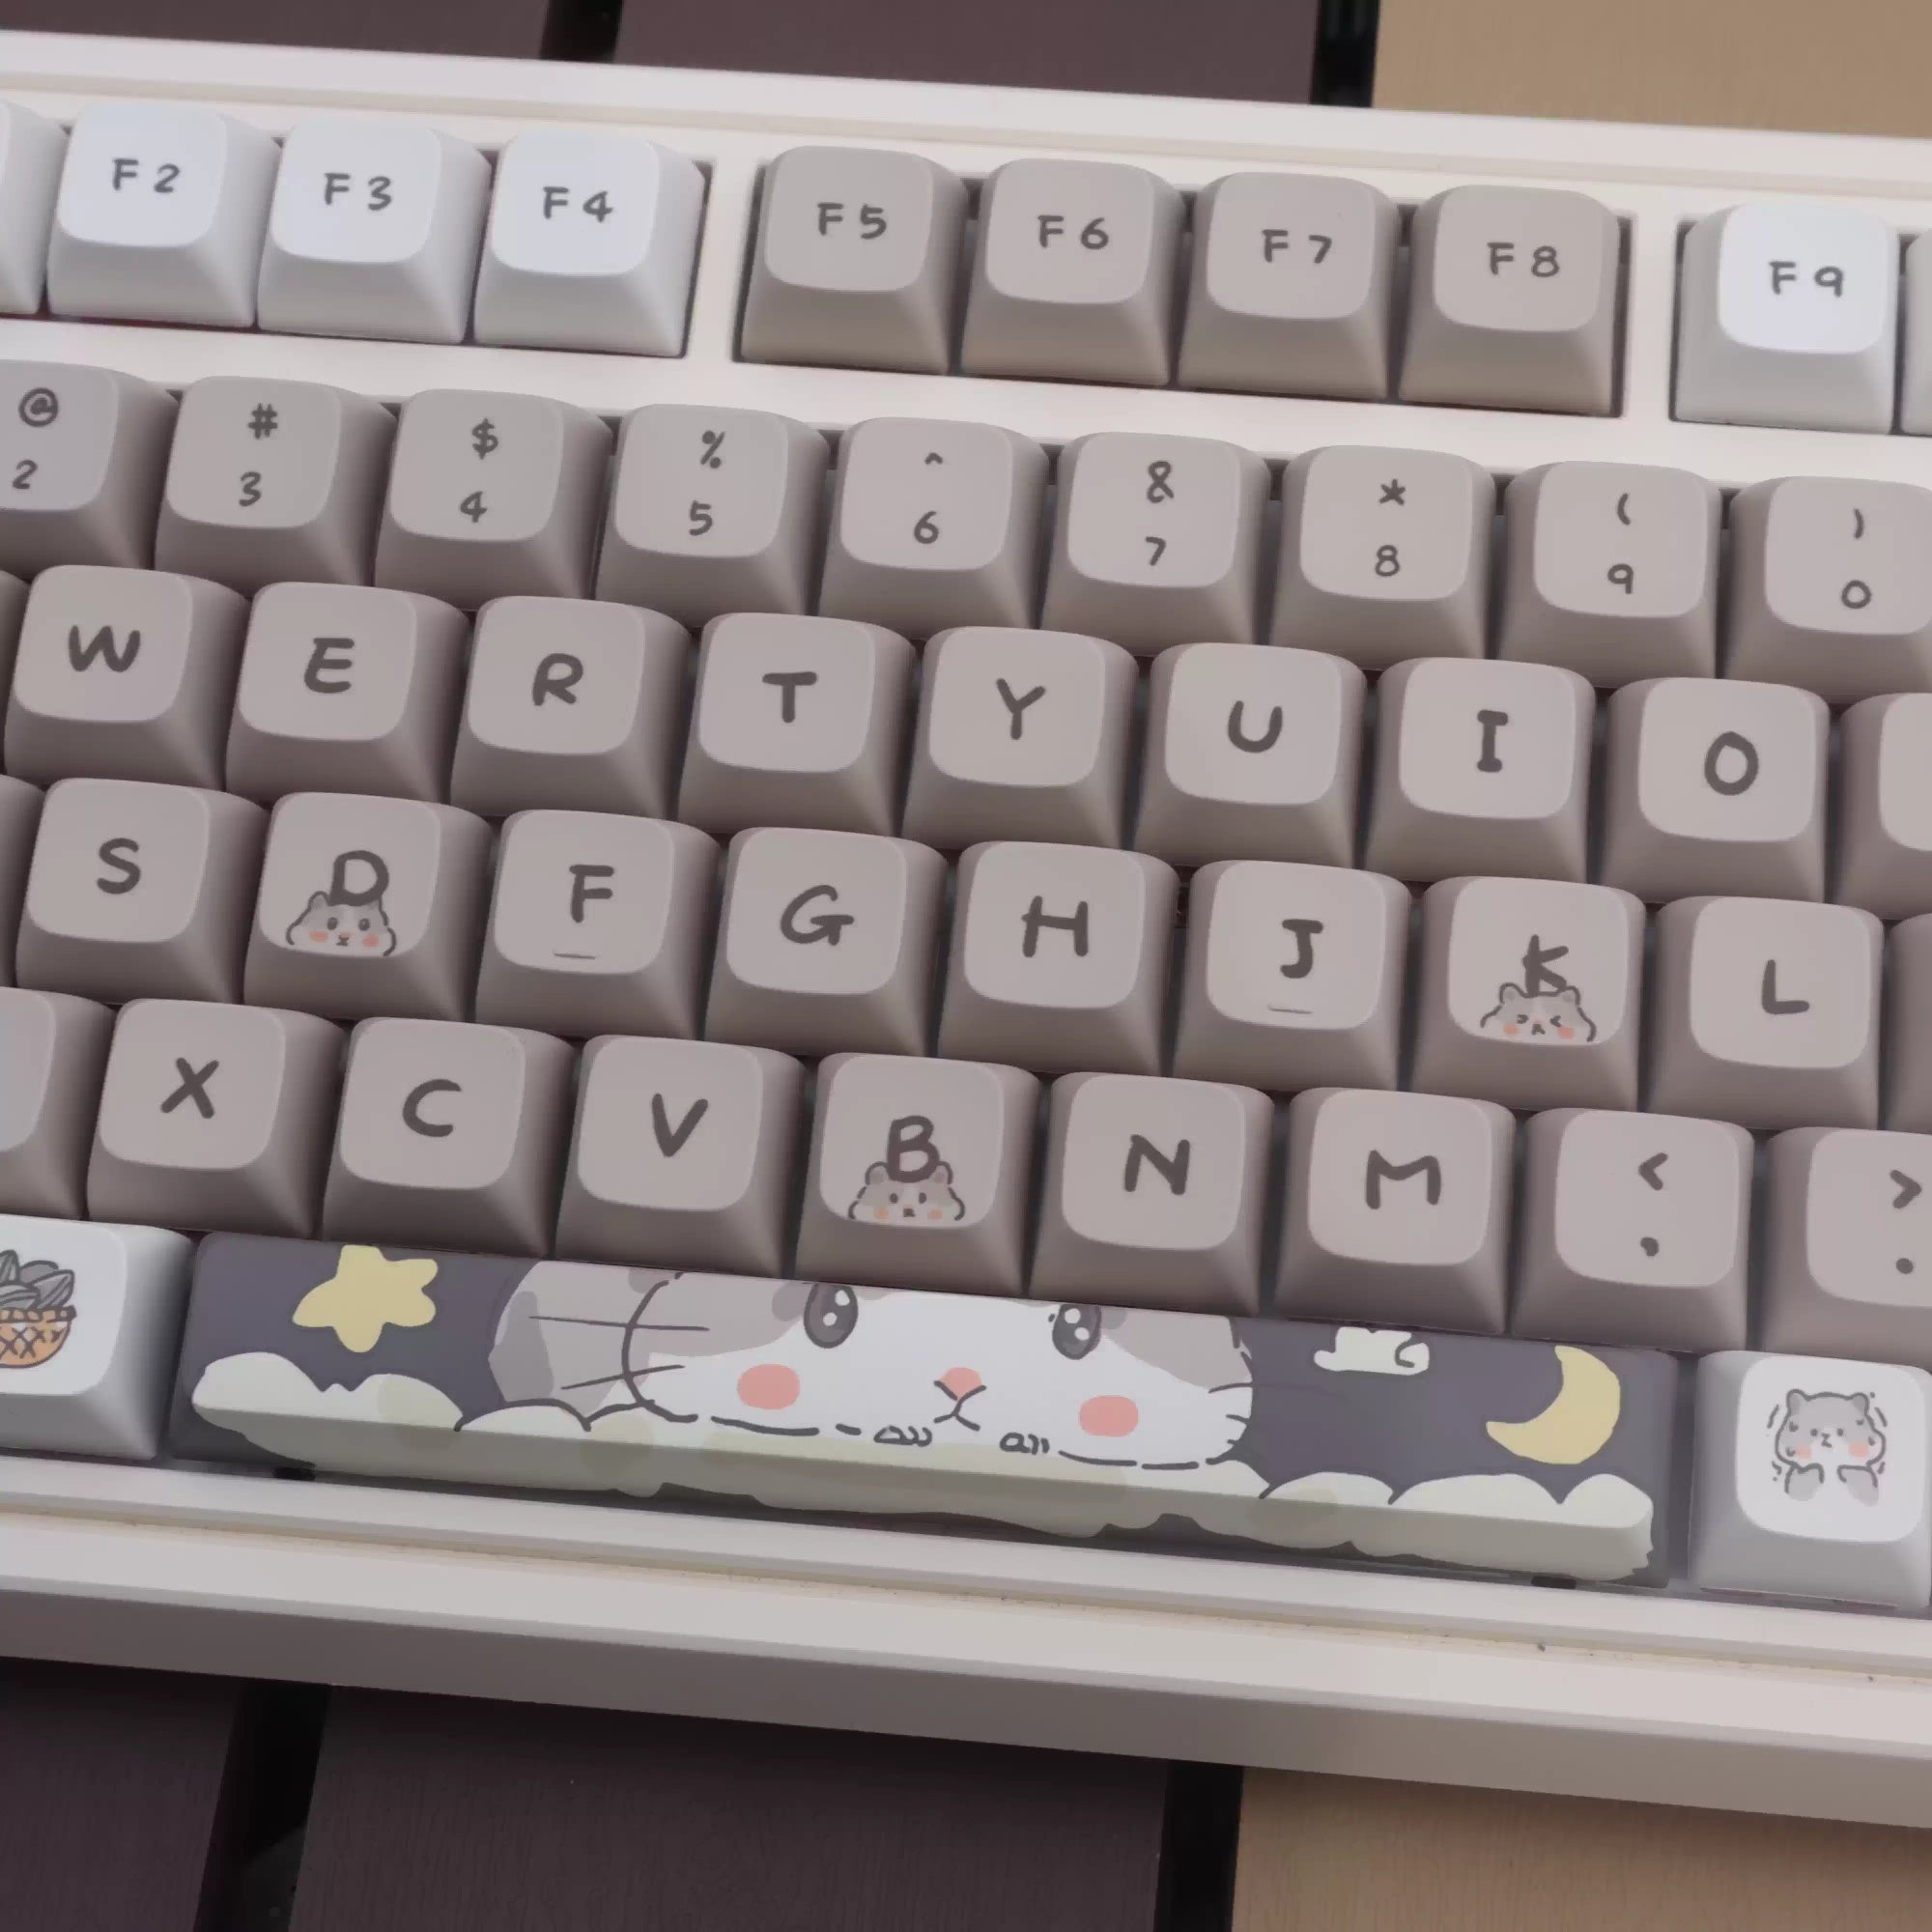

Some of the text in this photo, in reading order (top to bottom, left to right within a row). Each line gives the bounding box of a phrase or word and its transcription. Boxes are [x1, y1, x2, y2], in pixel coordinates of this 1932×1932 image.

[17, 387, 59, 428] @
[248, 403, 278, 440] #
[472, 417, 499, 460] $
[699, 430, 725, 469] %
[12, 460, 38, 490] 2
[239, 471, 262, 507] 3
[1146, 460, 1175, 504] &
[460, 491, 488, 524] 4
[689, 499, 713, 537] 5
[913, 510, 940, 545] 6
[1616, 493, 1631, 526] (
[1853, 508, 1864, 540] )
[1145, 536, 1167, 566] 7
[1375, 544, 1401, 578] 8
[1606, 563, 1634, 595] 9
[68, 625, 141, 673] W
[303, 637, 355, 695] E
[531, 652, 584, 707] R
[761, 670, 818, 724] T
[996, 678, 1046, 741] Y
[1227, 699, 1284, 753] U
[1476, 709, 1509, 774] I
[1703, 730, 1760, 797] O
[96, 837, 142, 895] S
[329, 849, 390, 906] D
[568, 864, 615, 923] F
[780, 884, 855, 947] G
[1021, 895, 1089, 958] H
[1279, 918, 1324, 980] J
[1521, 933, 1570, 996] K
[1761, 959, 1810, 1016] L
[160, 1057, 219, 1120] X
[402, 1078, 462, 1138] C
[651, 1093, 709, 1158] V
[886, 1116, 940, 1183] B
[1123, 1134, 1191, 1196] N
[1365, 1150, 1442, 1210] M
[1637, 1152, 1668, 1191] <
[1889, 1169, 1922, 1209] >
